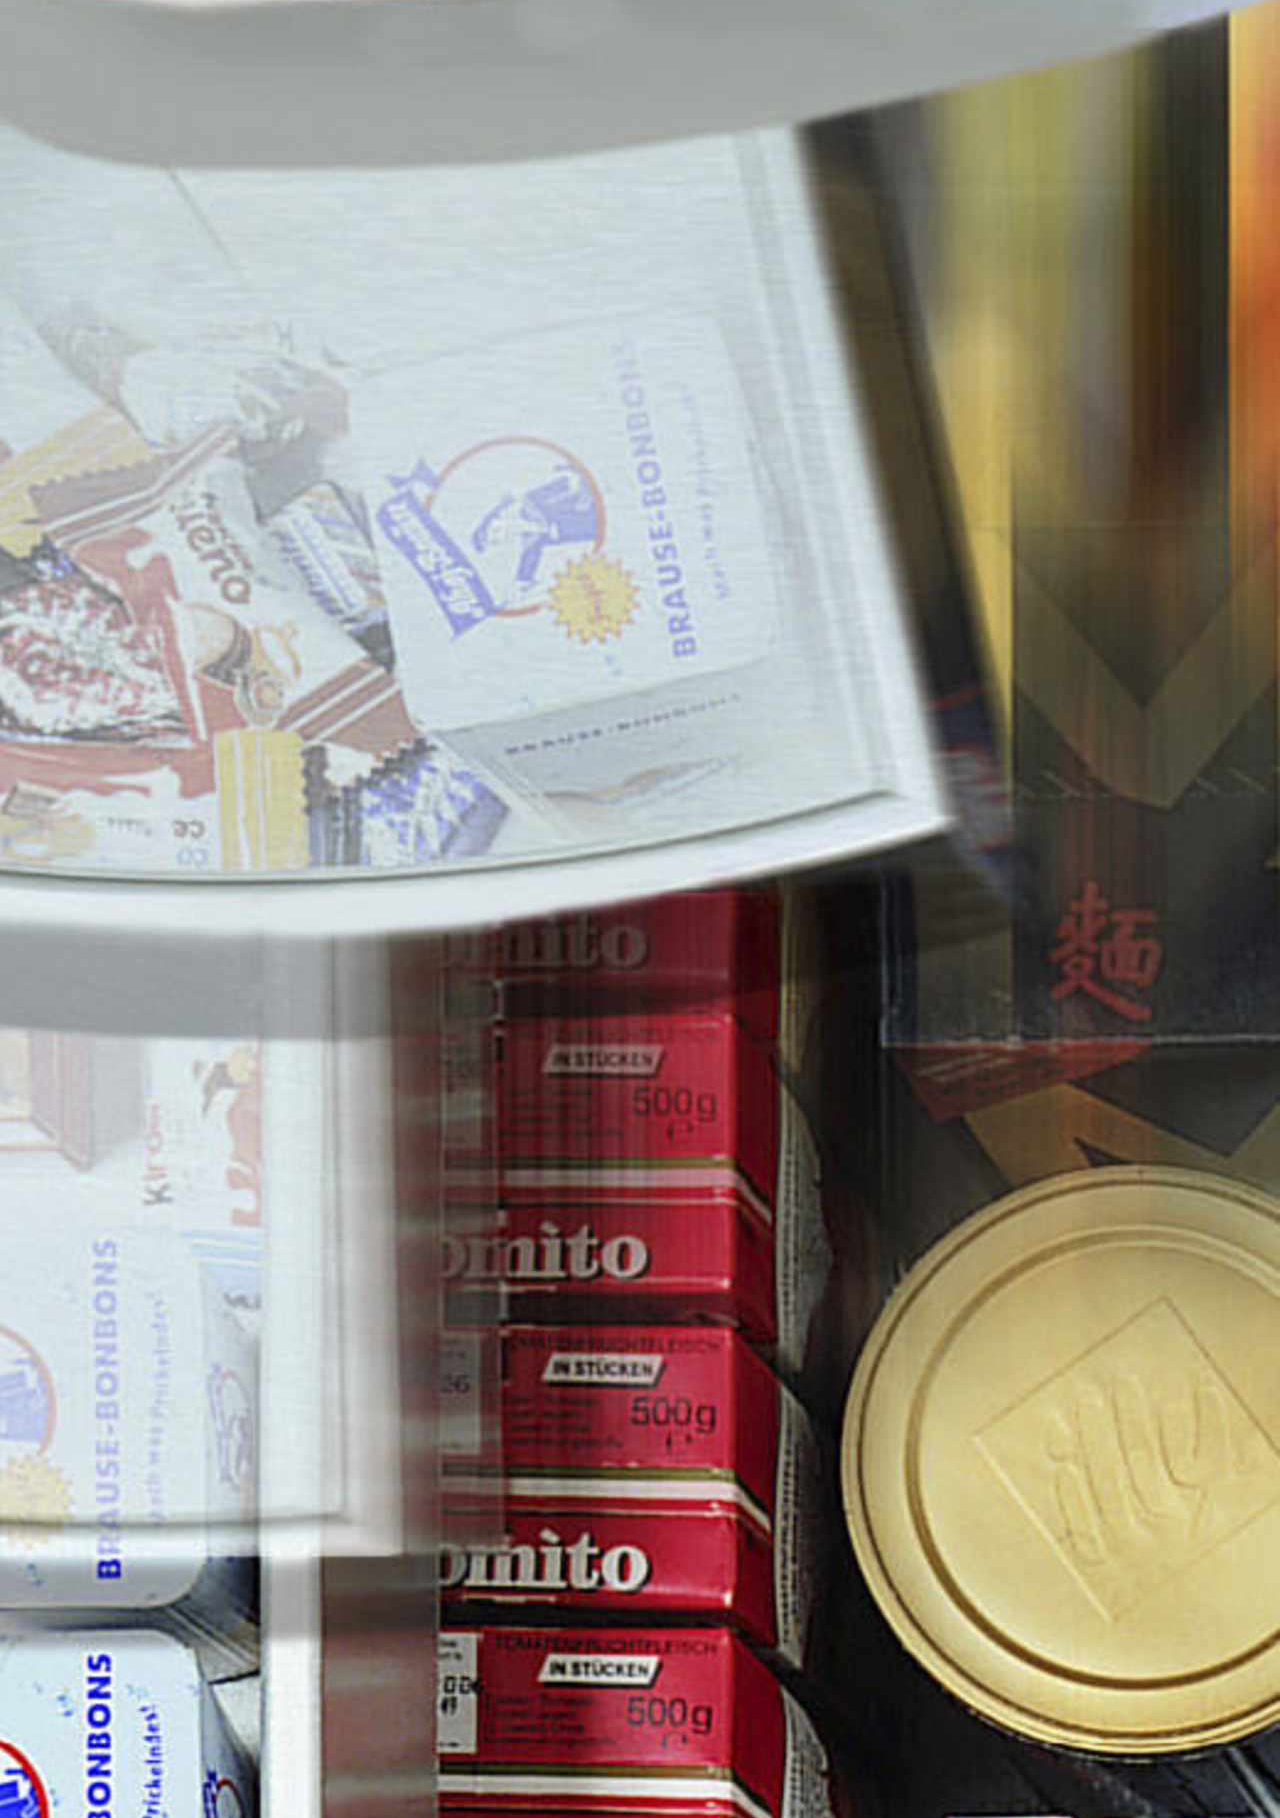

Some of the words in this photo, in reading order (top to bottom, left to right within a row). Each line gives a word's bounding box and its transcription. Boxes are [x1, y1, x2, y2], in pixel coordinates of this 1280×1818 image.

[574, 1357, 653, 1377] STÜCKEN
[549, 1661, 567, 1677] IN
[571, 1658, 651, 1677] STÜCKEN
